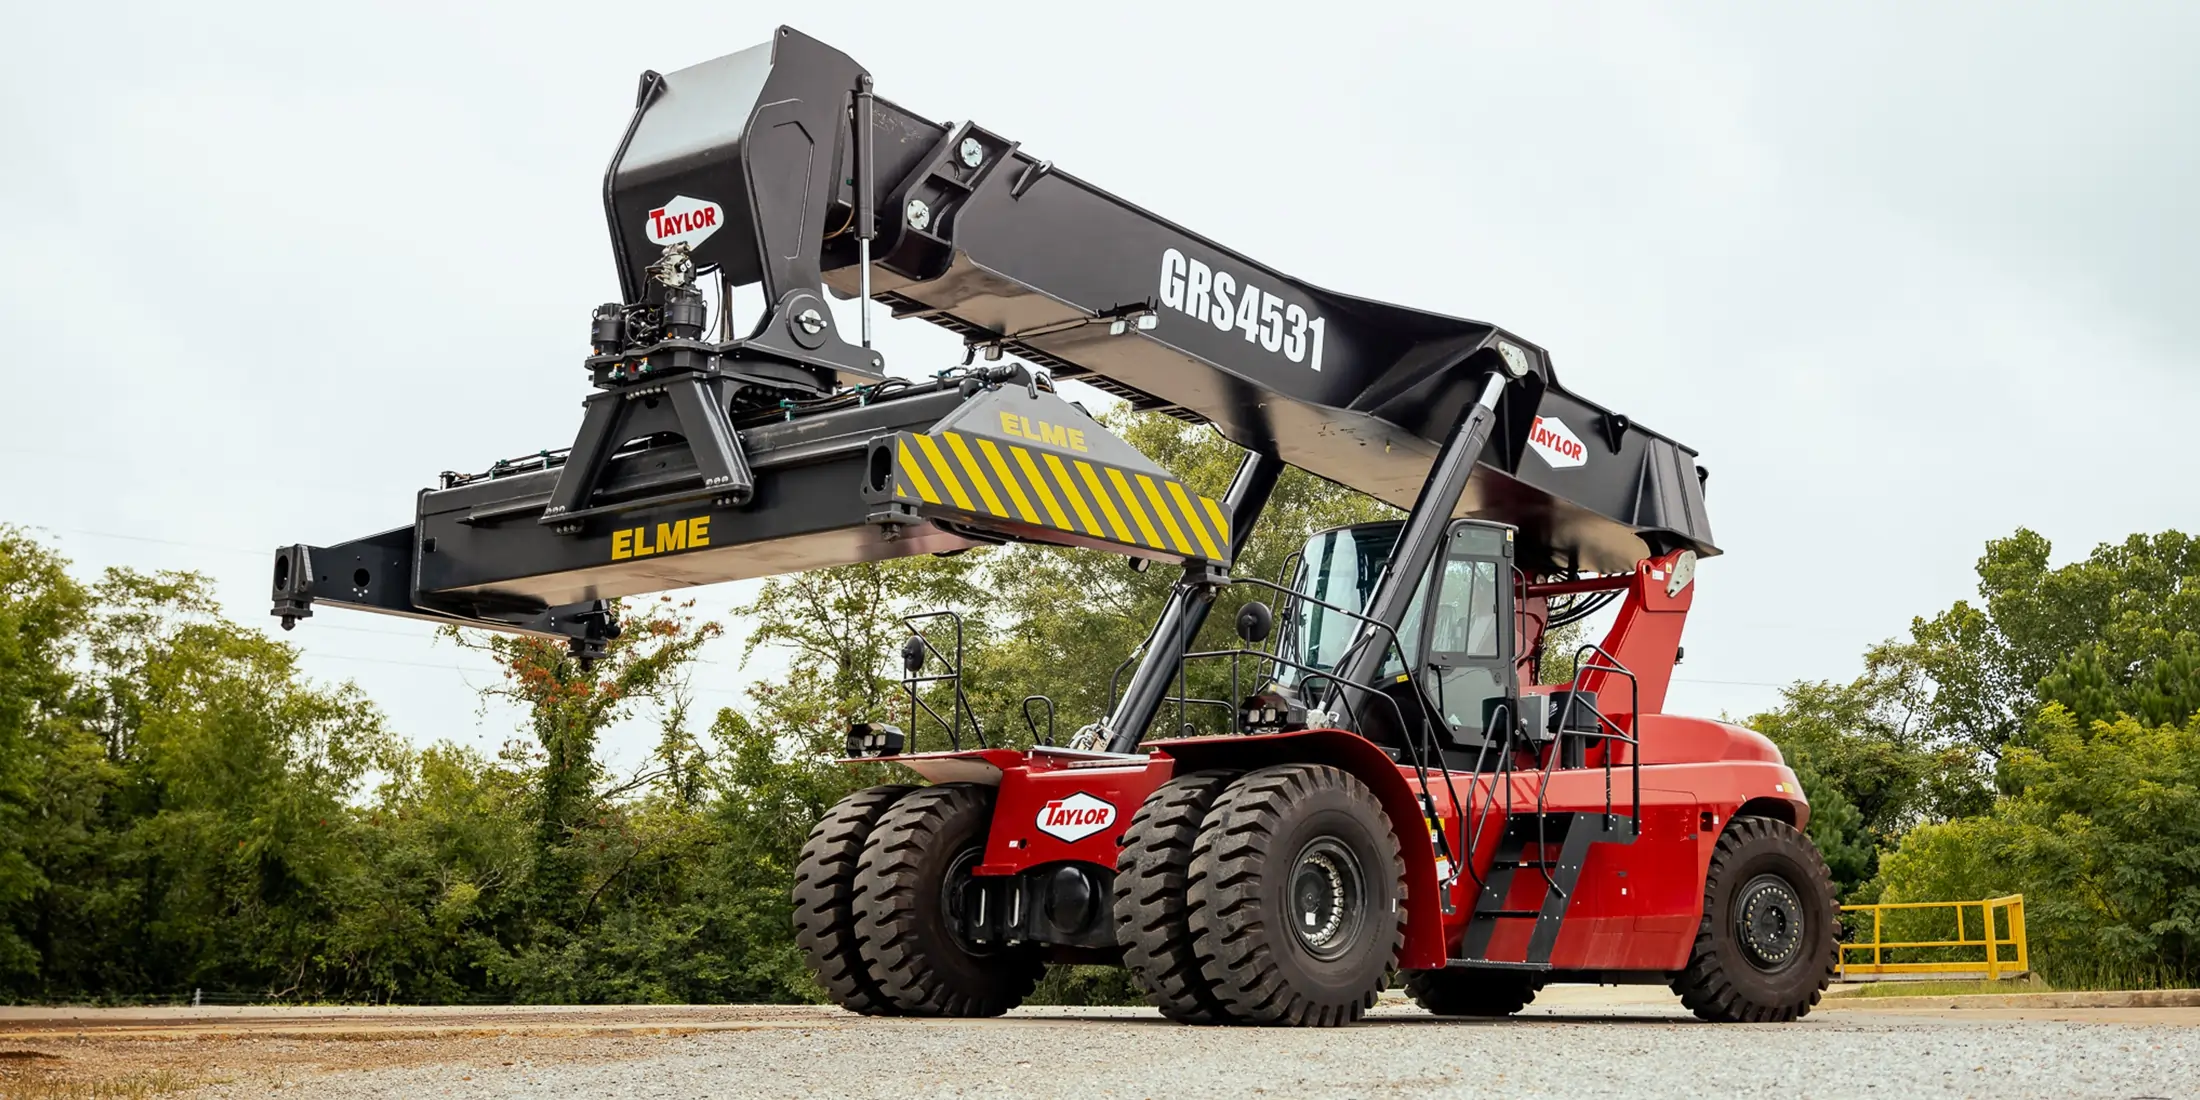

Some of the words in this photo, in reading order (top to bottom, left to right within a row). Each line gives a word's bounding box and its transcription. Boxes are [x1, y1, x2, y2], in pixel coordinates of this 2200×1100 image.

[650, 206, 716, 239] TAYLOR
[1159, 248, 1326, 372] GRS4531
[1000, 411, 1088, 453] ELME
[1530, 416, 1582, 461] TAYLOR
[612, 515, 710, 560] ELME
[1045, 801, 1109, 827] TAYLOR
